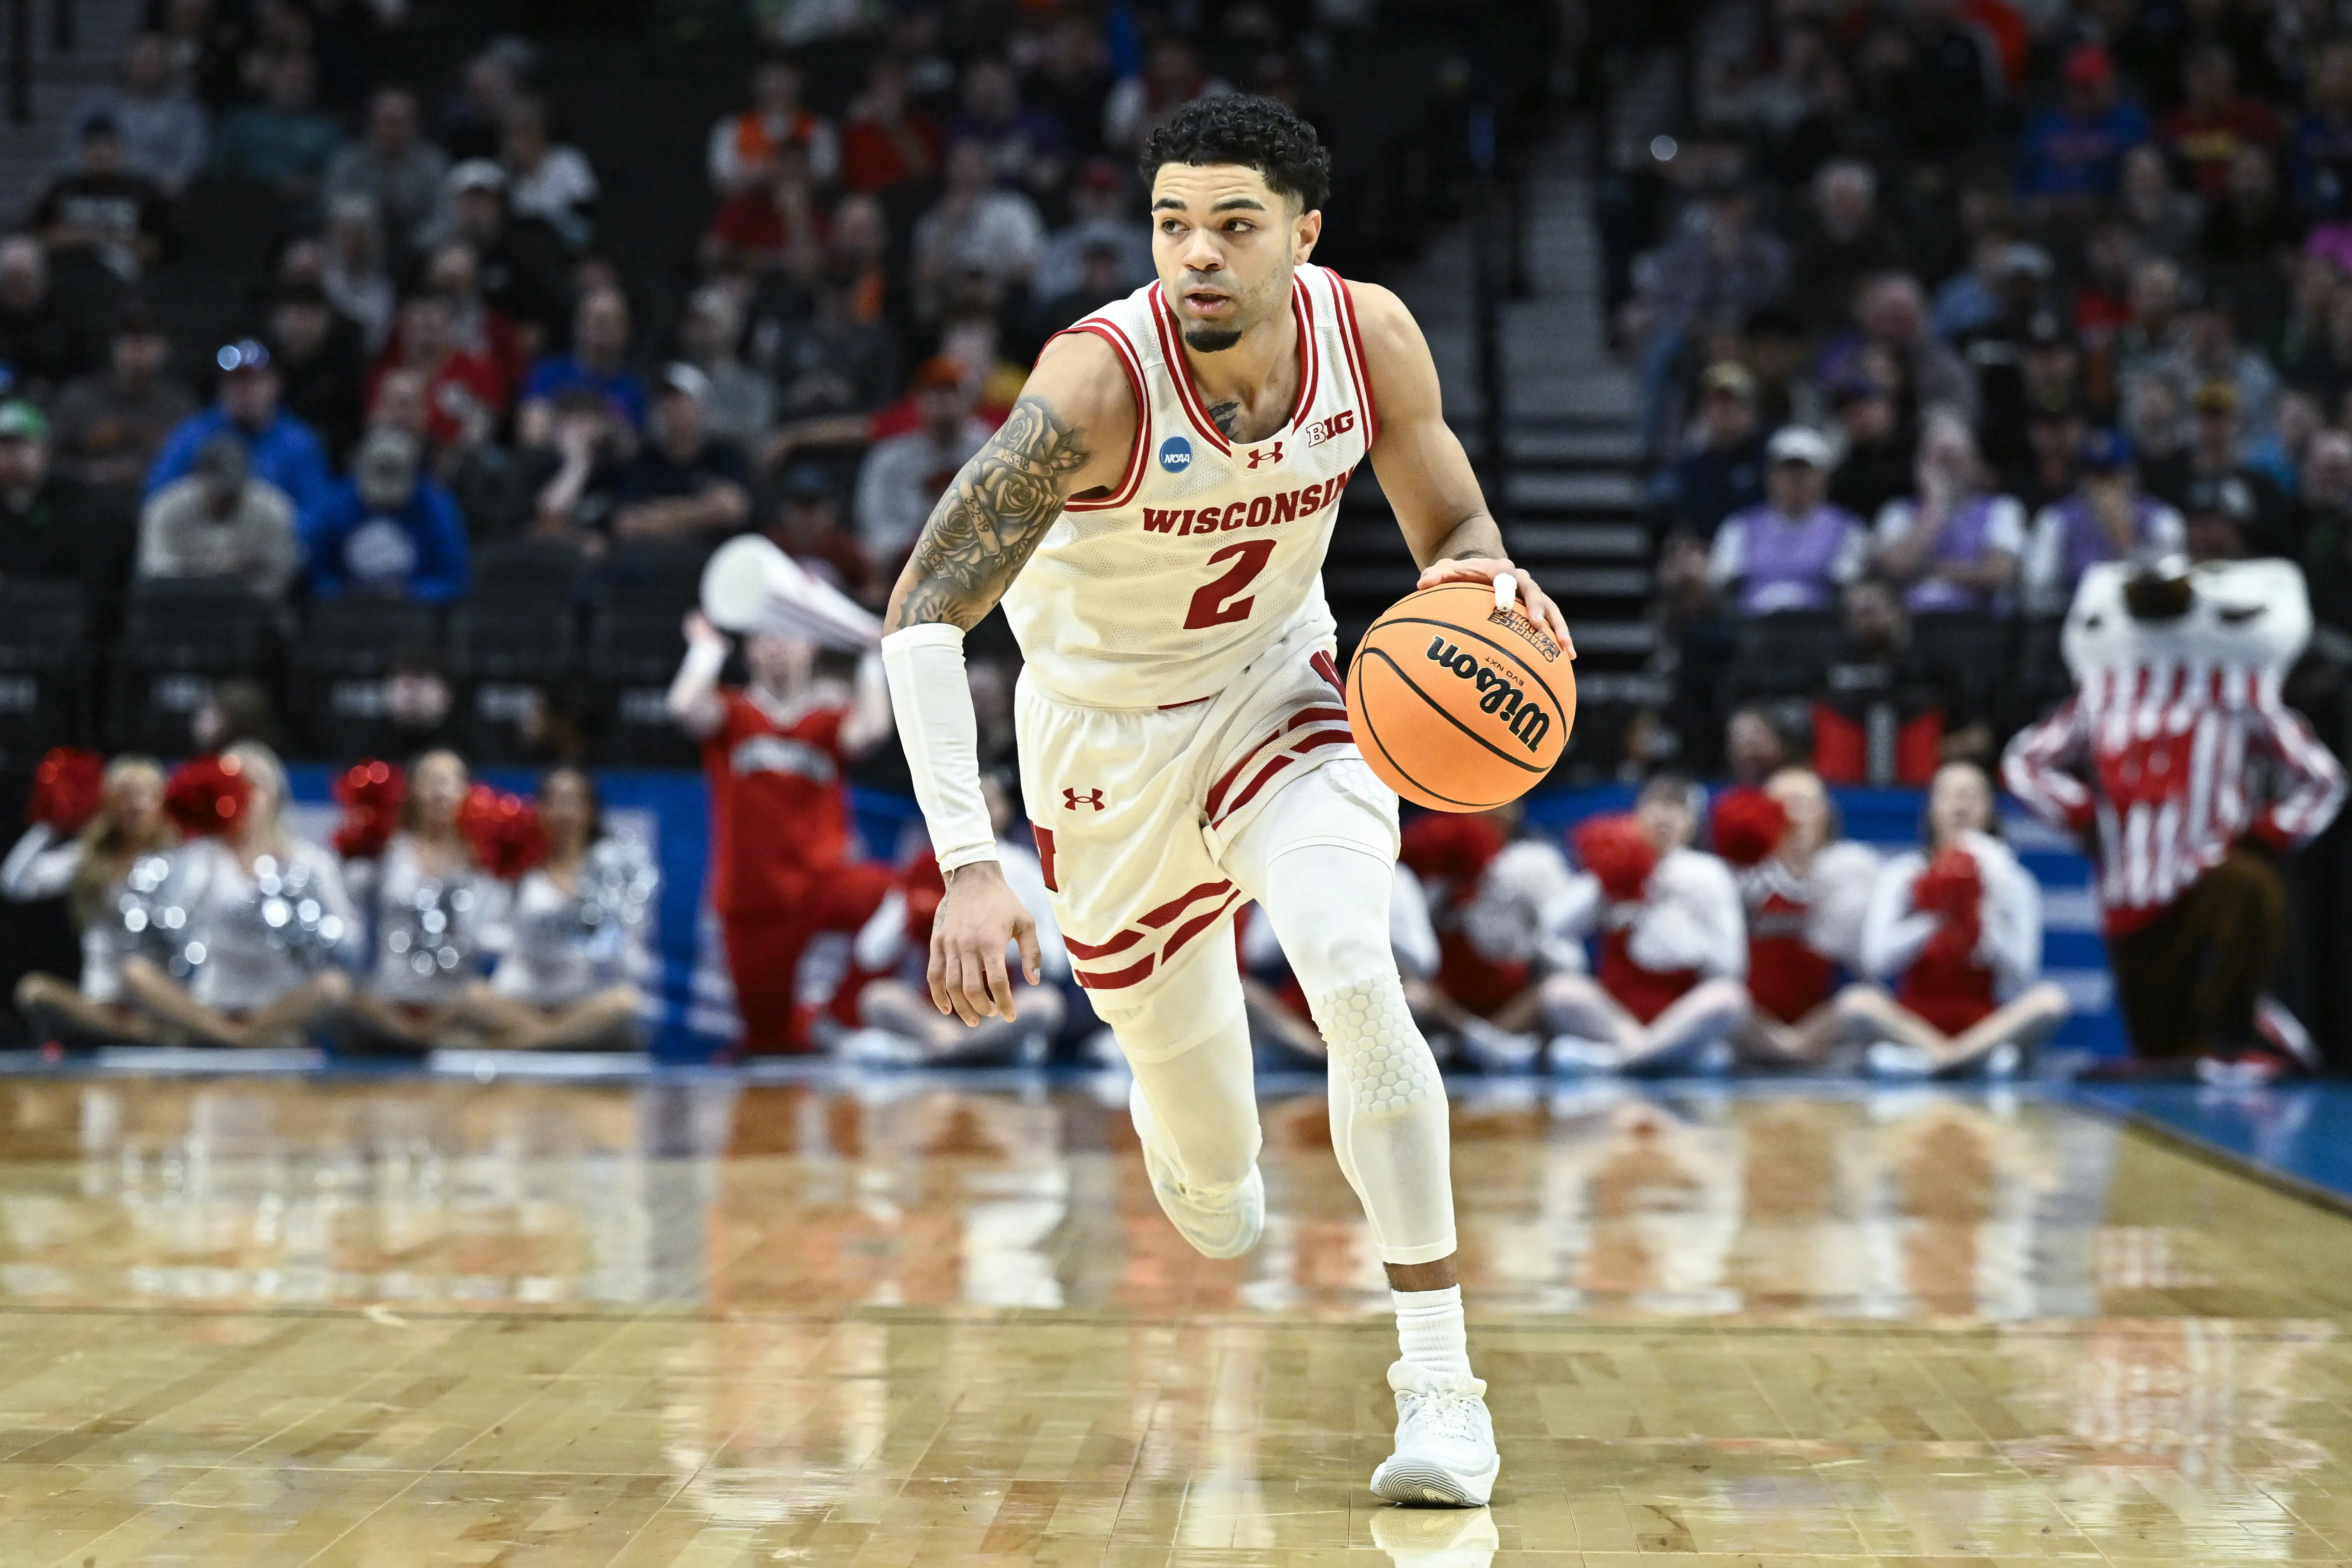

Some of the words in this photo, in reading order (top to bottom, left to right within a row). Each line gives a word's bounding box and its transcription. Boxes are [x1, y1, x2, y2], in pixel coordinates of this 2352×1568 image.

[1164, 454, 1190, 463] NCAA
[1143, 464, 1355, 537] WISCONSIN
[1182, 539, 1276, 630] 2
[1509, 622, 1546, 652] MARCH
[1484, 656, 1504, 672] NXT
[1505, 670, 1524, 687] EVO
[1426, 634, 1550, 754] Wilson
